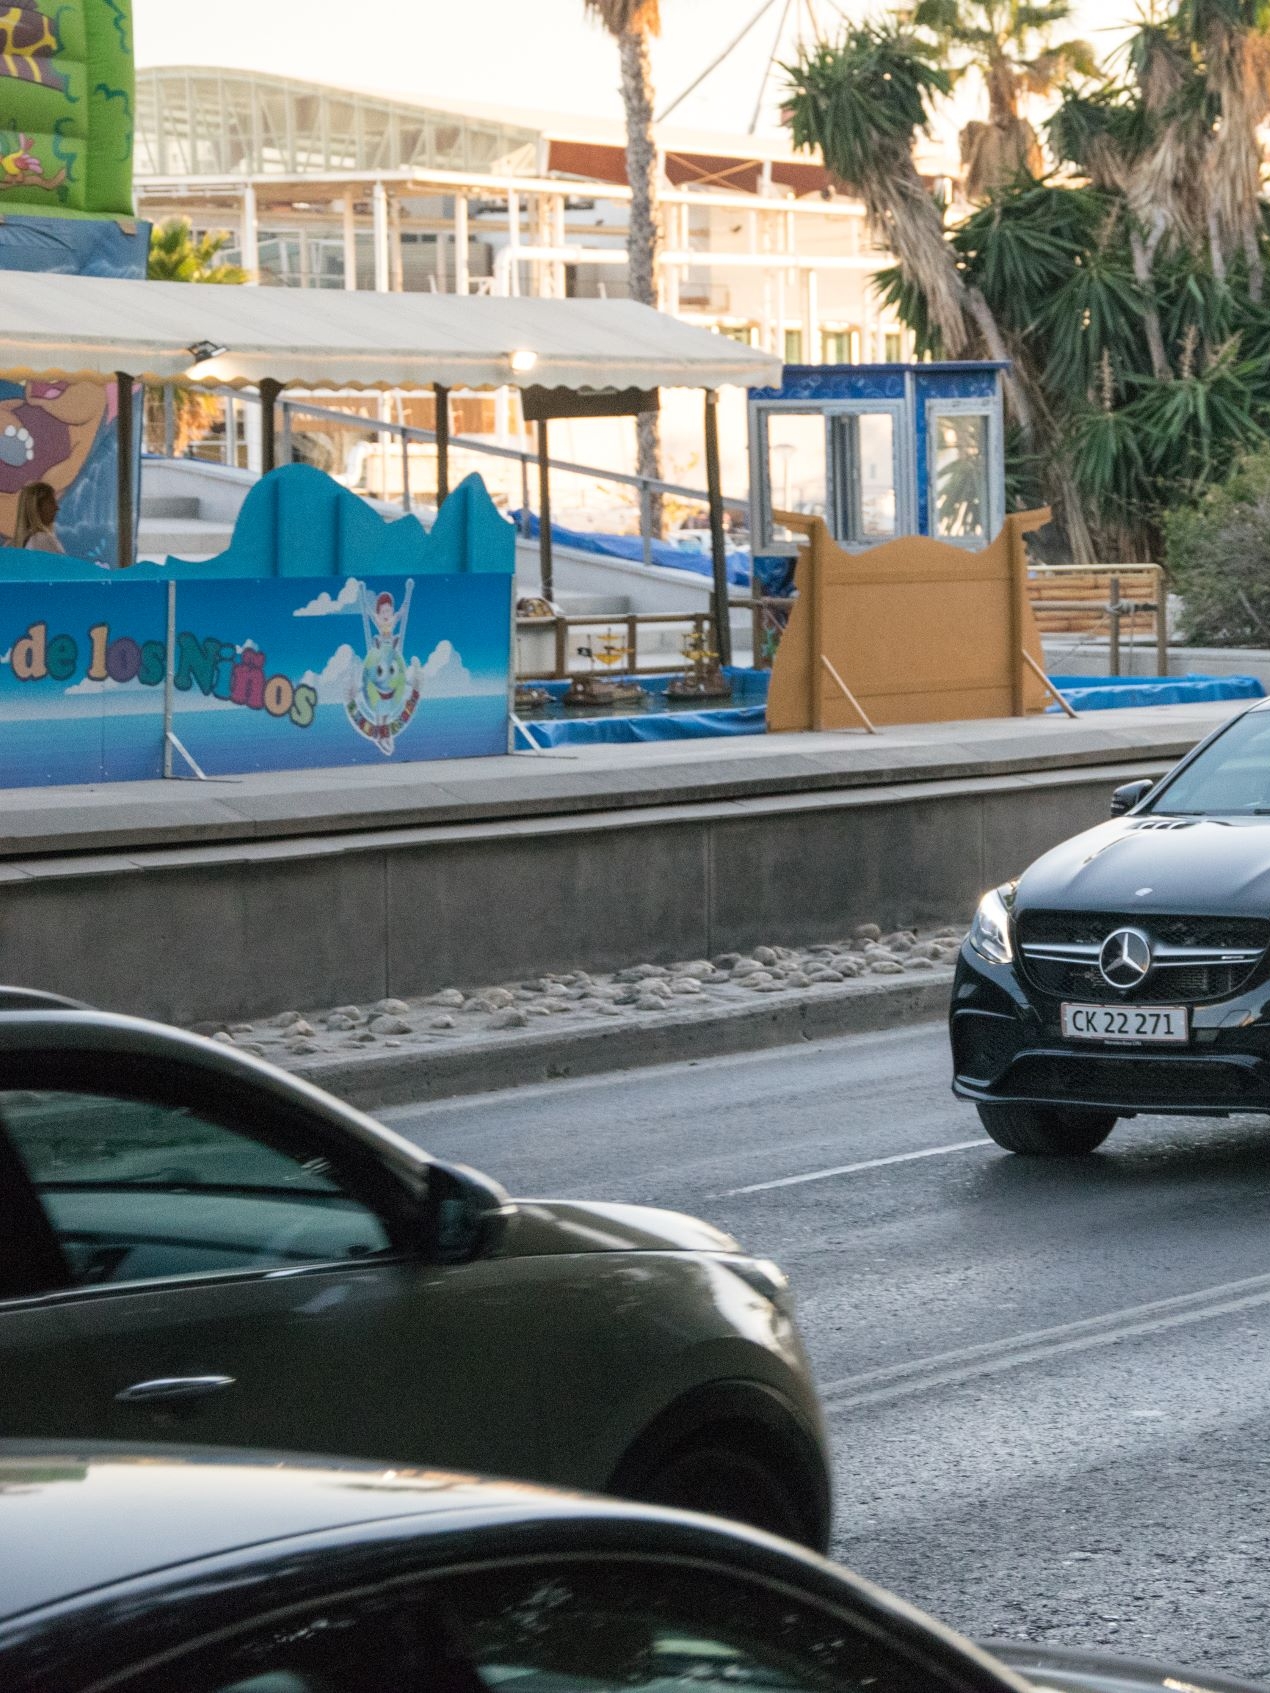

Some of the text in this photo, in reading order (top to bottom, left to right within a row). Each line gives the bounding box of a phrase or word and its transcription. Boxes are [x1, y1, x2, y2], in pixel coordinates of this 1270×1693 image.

[11, 620, 77, 681] de
[88, 622, 166, 687] los
[173, 631, 317, 727] Niños
[1072, 1010, 1174, 1035] CK 22 271
